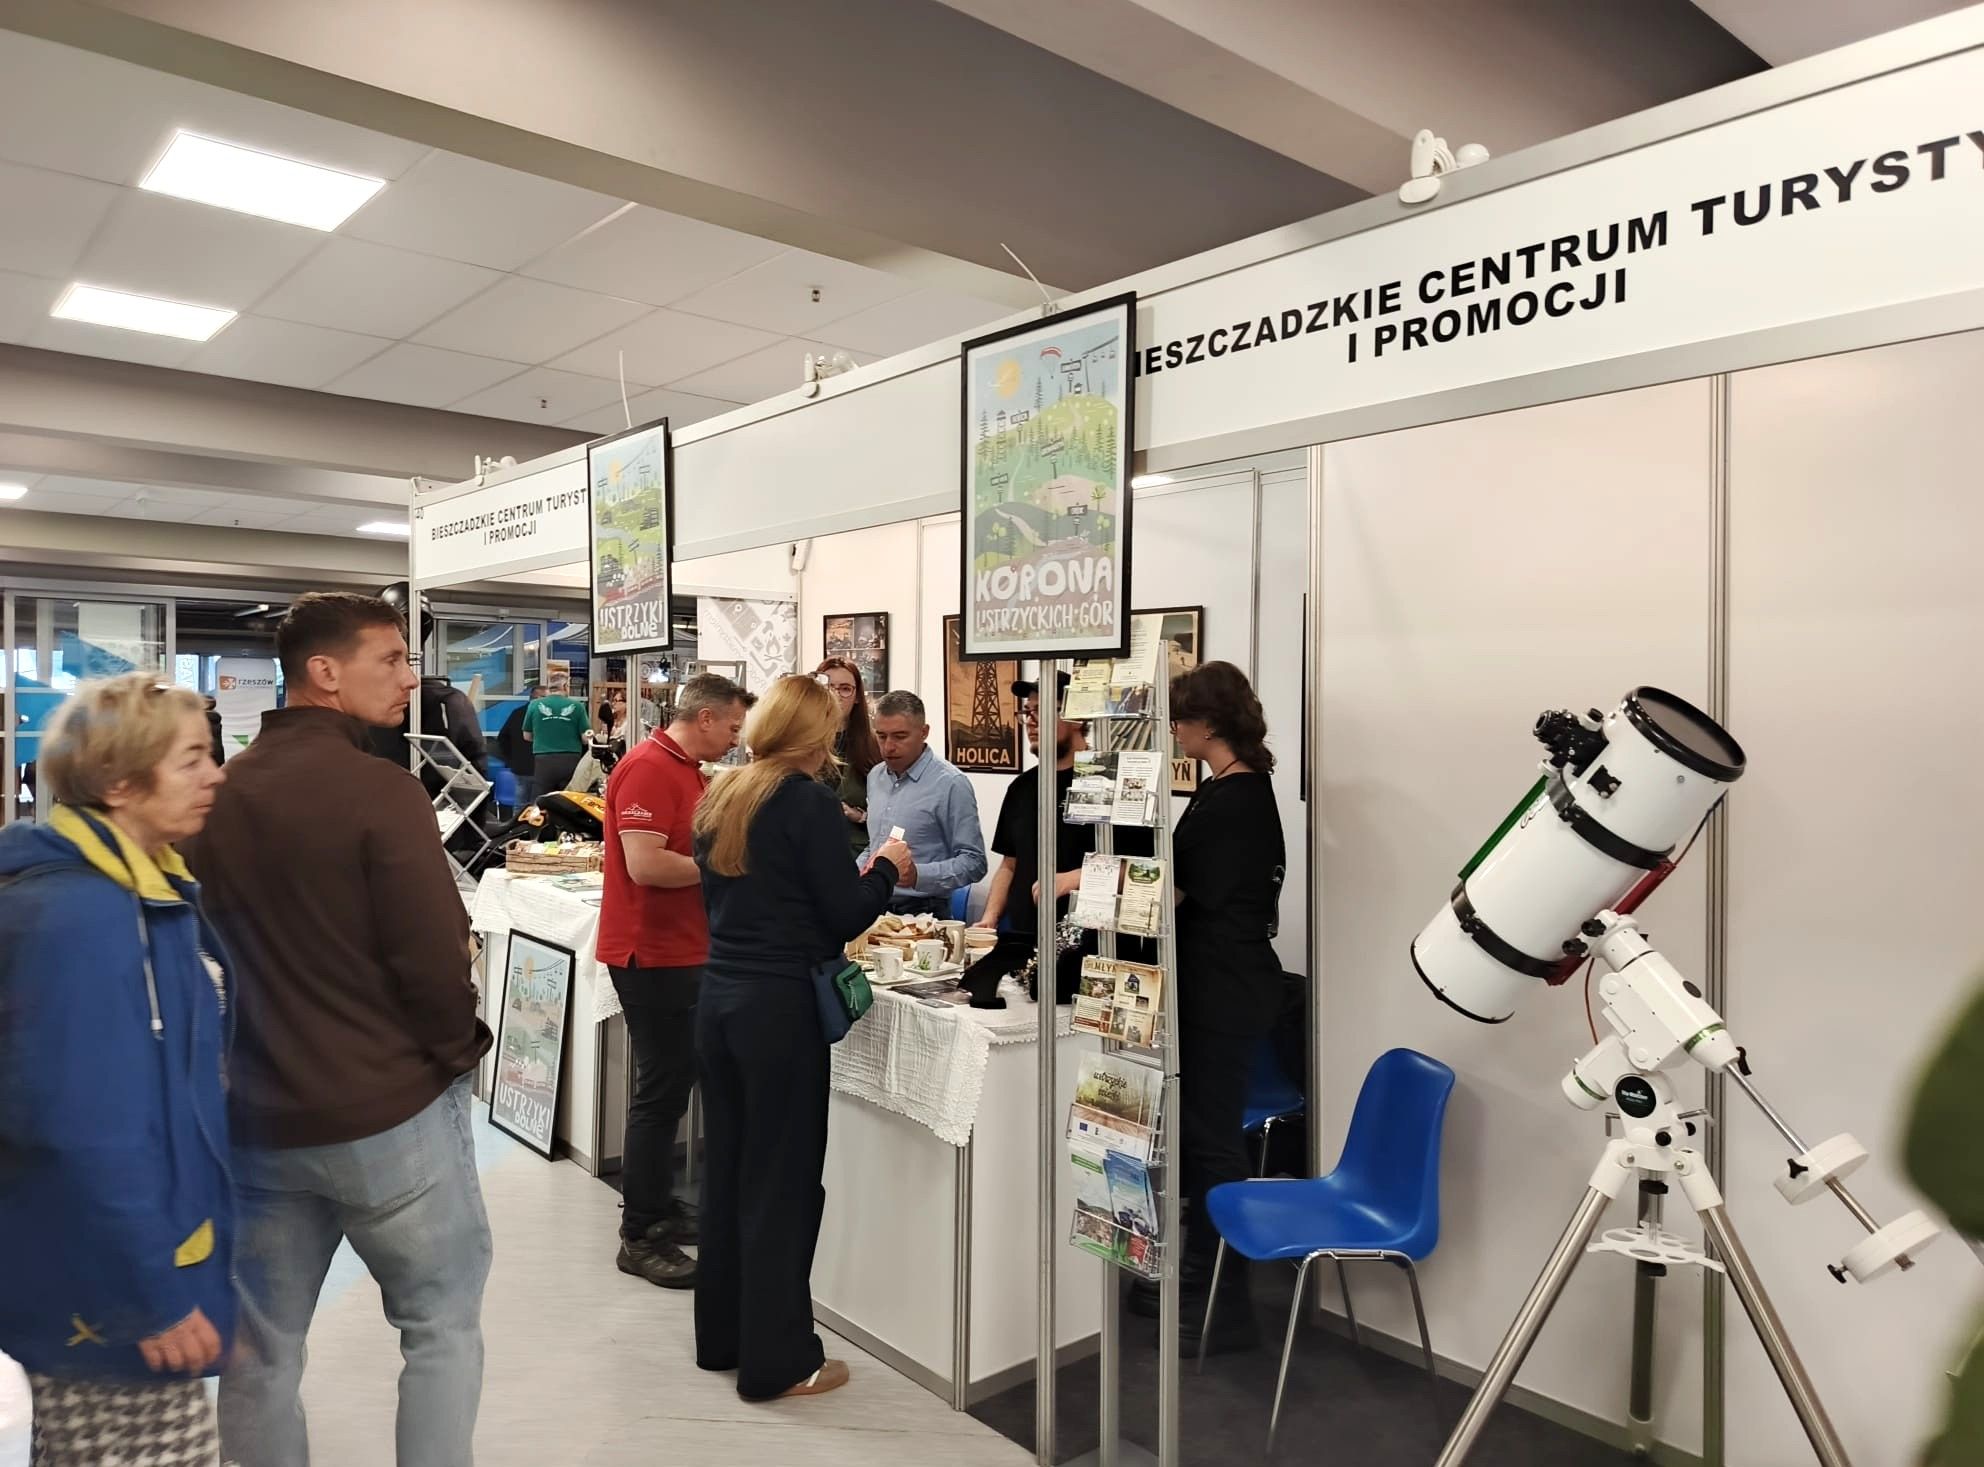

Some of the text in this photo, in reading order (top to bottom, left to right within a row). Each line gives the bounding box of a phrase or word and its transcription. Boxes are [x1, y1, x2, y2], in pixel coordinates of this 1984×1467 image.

[1134, 280, 1401, 377] IESZCZADZKIE
[1418, 210, 1668, 304] CENTRUM
[1347, 267, 1627, 364] I PROMOCJI
[431, 488, 587, 541] BIESZCZADZKIE CENTRUM TURYST
[483, 519, 537, 546] I PROMOCJI
[976, 556, 1113, 602] KORONA
[600, 600, 663, 630] USTRZYKI
[976, 594, 1113, 633] USTRZYCKICH GÓR
[238, 678, 274, 686] rzeszów
[956, 747, 1011, 765] HOLICA
[500, 1082, 551, 1130] USTRZYKI
